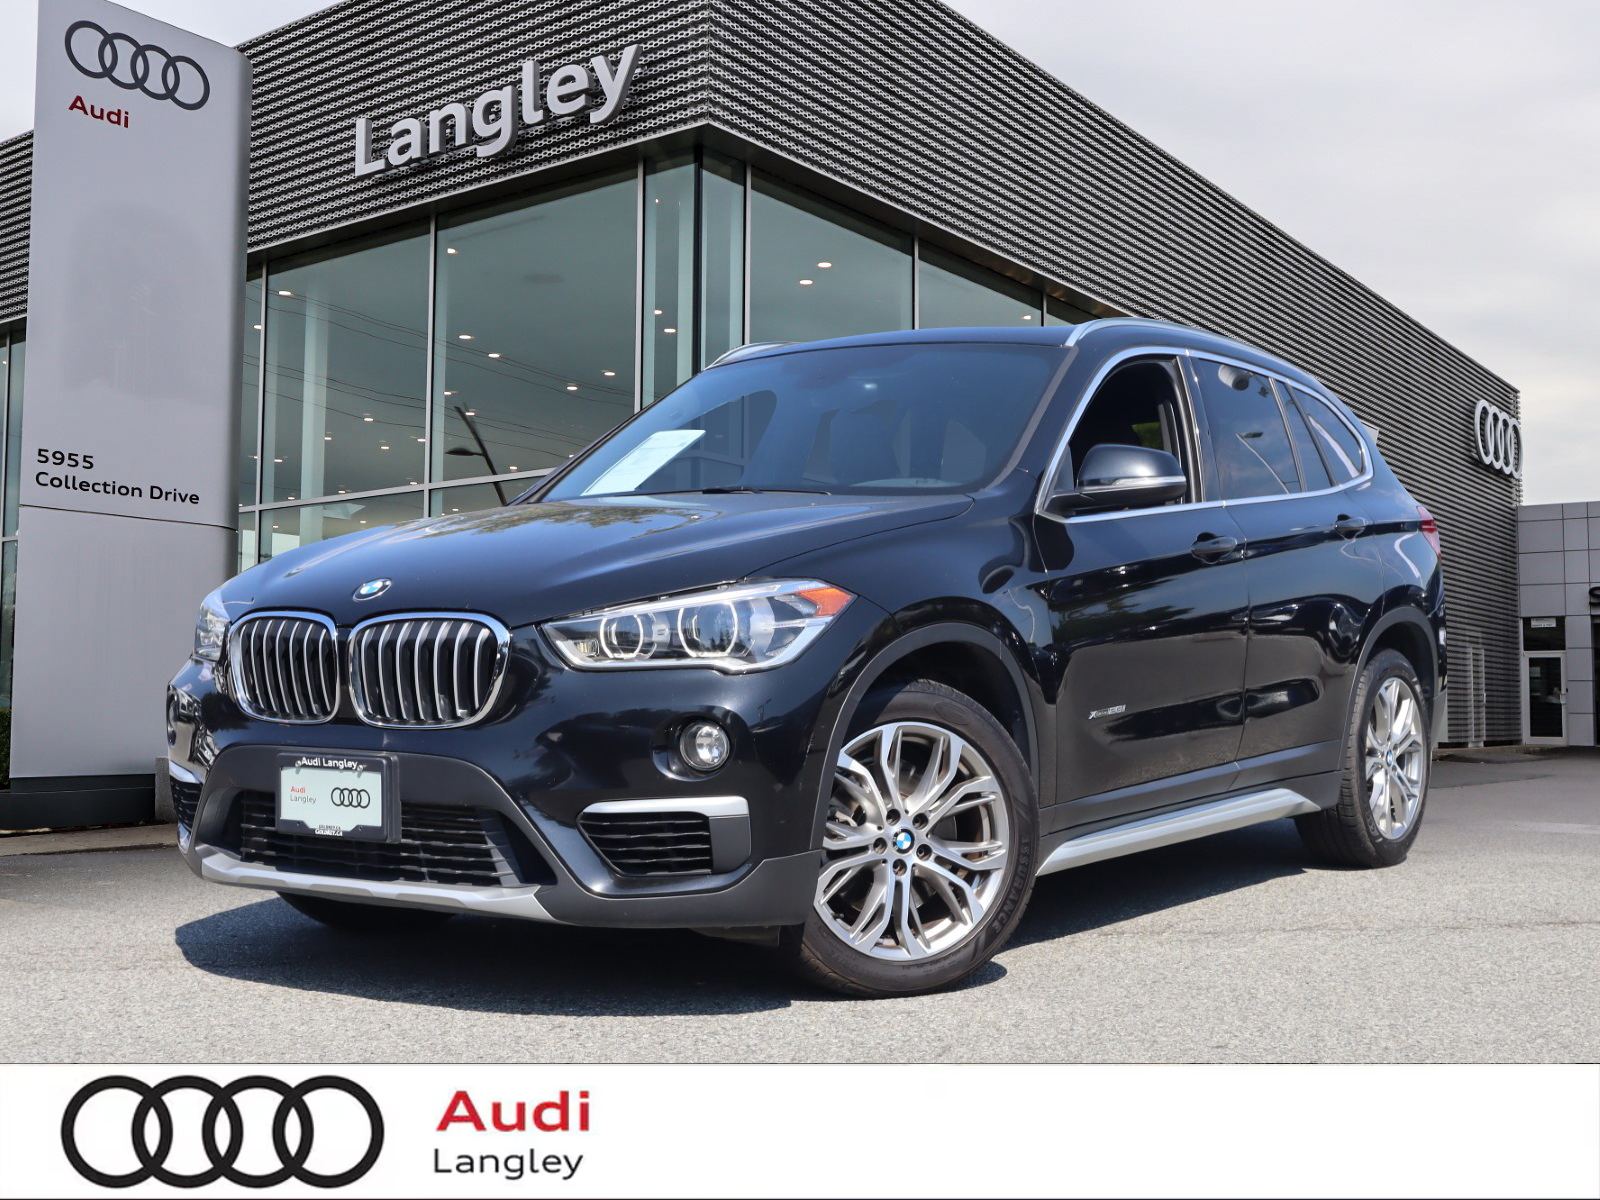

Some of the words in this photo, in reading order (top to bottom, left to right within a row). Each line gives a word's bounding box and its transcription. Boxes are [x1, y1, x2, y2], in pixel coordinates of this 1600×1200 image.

[68, 95, 129, 129] Audi
[354, 44, 643, 177] Langley
[37, 448, 94, 470] 5955
[35, 471, 143, 498] Collection
[149, 485, 200, 505] Drive
[301, 757, 321, 767] Audi
[322, 758, 358, 769] Langley
[290, 795, 317, 804] Langley
